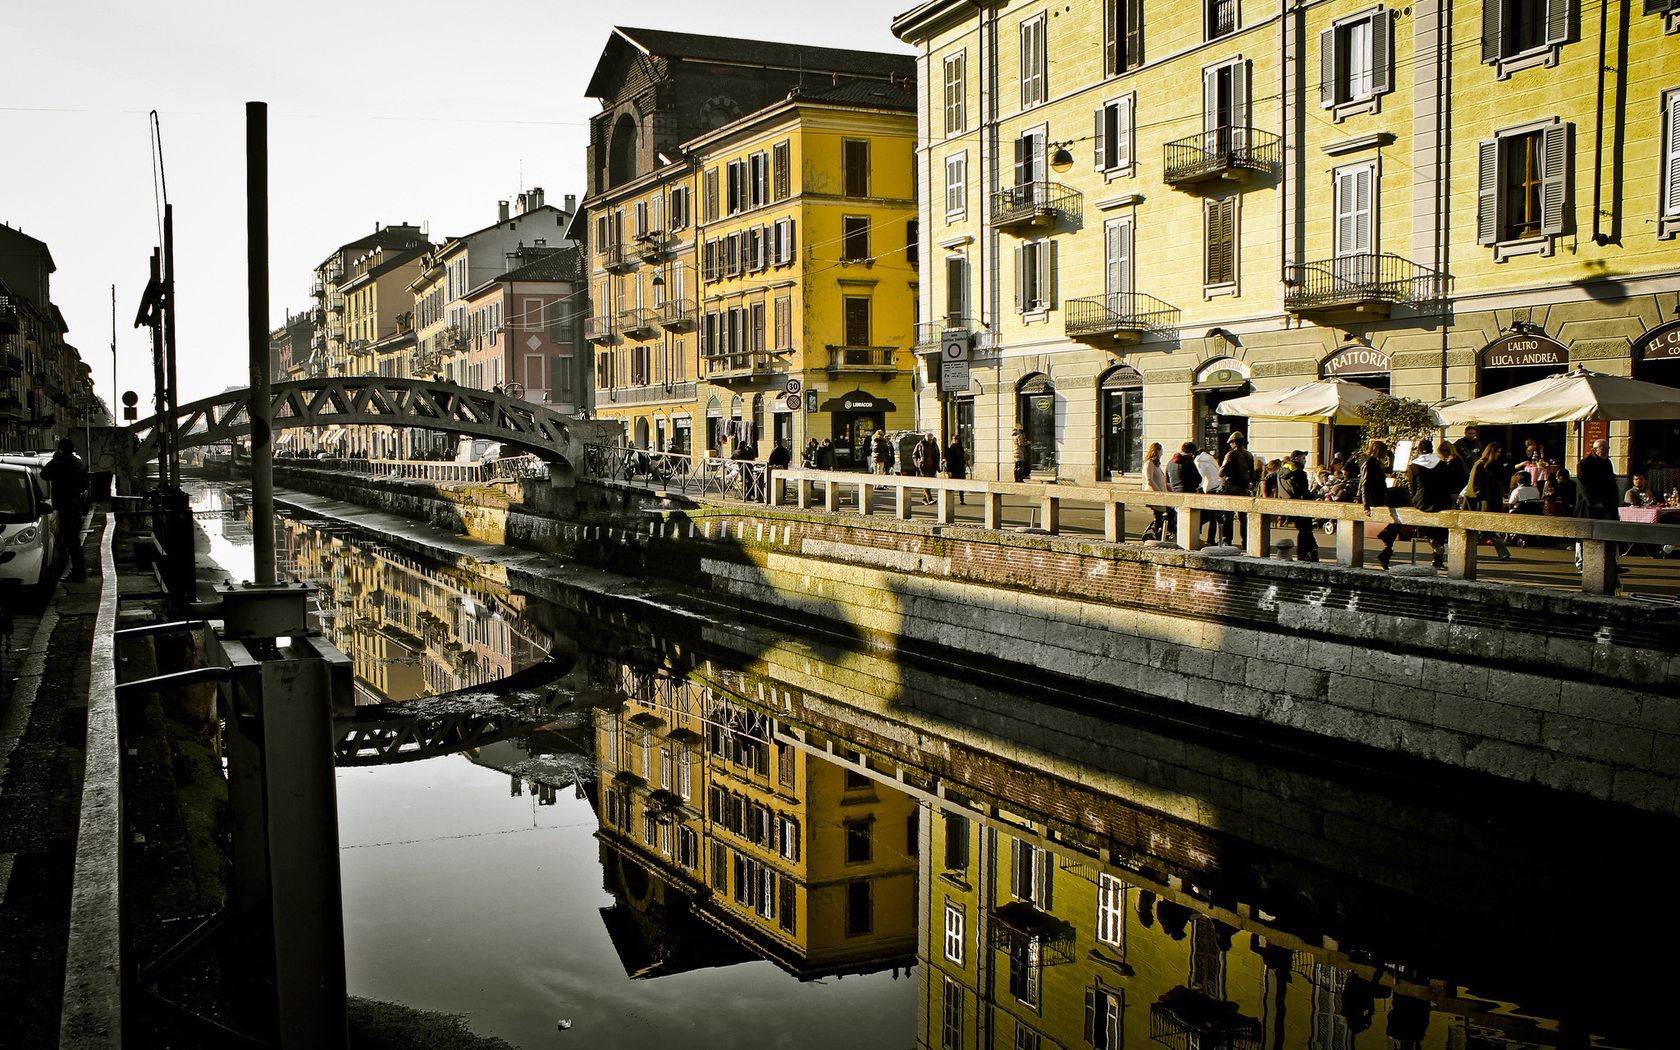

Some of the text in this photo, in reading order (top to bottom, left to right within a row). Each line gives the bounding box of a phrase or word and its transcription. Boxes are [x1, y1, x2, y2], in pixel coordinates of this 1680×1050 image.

[1508, 340, 1538, 351] L'ALTRO
[1649, 338, 1664, 351] EL
[1668, 347, 1680, 355] CO
[1324, 351, 1388, 374] TRATTORIA
[1491, 355, 1514, 366] LUCA
[1522, 352, 1559, 364] ANDREA
